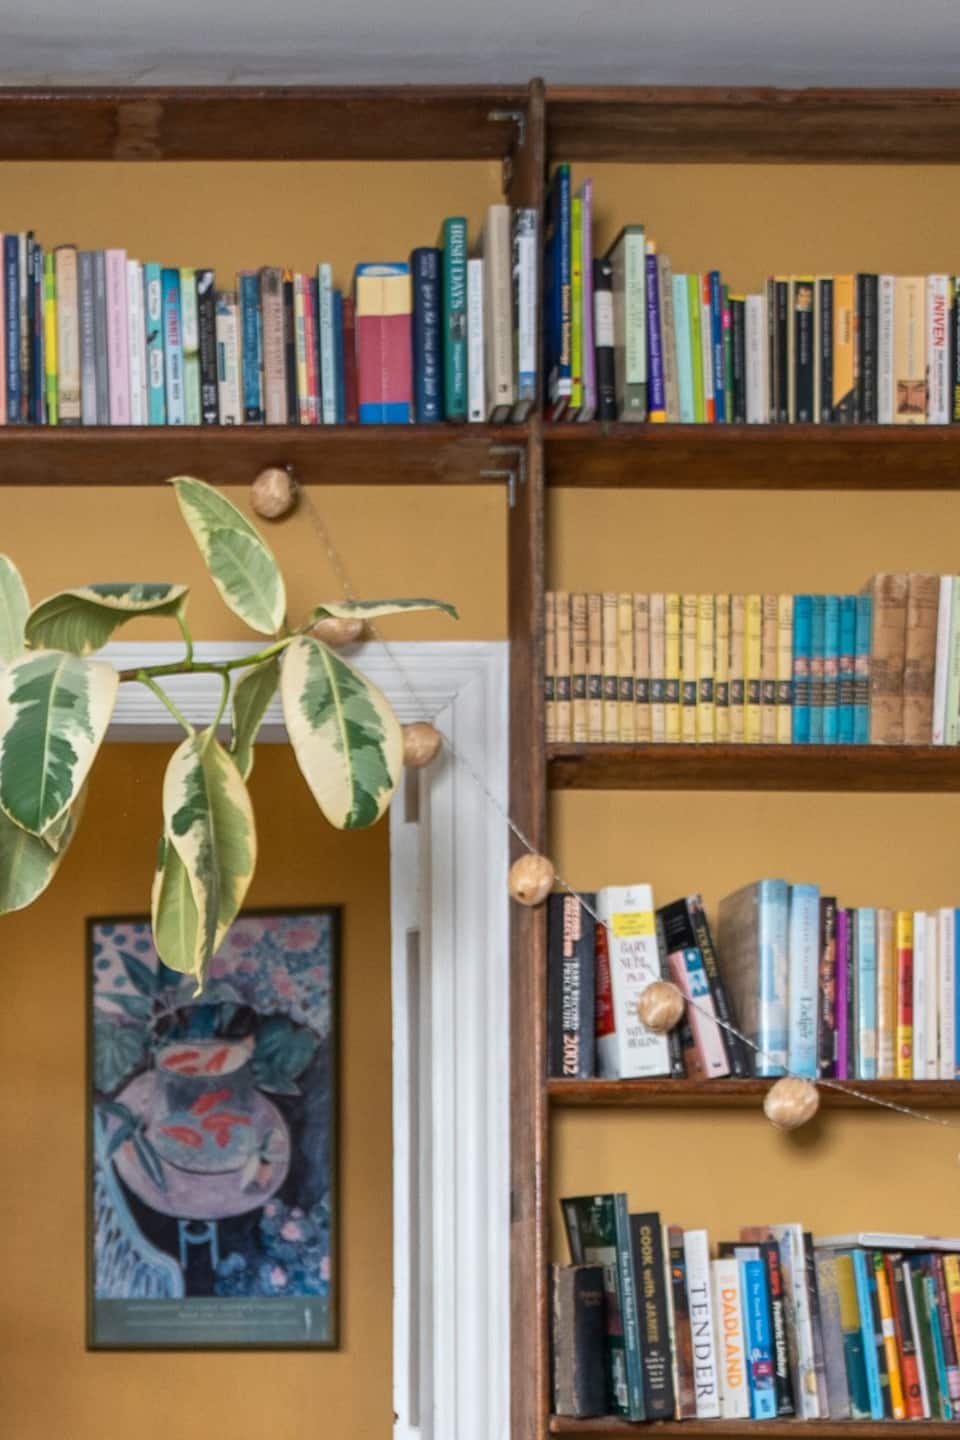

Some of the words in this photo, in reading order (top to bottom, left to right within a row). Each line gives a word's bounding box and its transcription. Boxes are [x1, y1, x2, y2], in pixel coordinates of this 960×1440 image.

[450, 223, 466, 264] IRISH
[450, 267, 467, 309] DAYS
[560, 284, 570, 314] Science
[933, 300, 945, 347] NIVEN
[559, 323, 571, 366] Technology
[620, 942, 647, 953] GARY
[563, 1034, 580, 1075] 2002
[640, 1225, 654, 1266] COOK
[644, 1268, 657, 1298] with
[645, 1301, 659, 1344] JAMIE
[690, 1282, 715, 1399] TENDER
[721, 1287, 743, 1389] DADLAND
[775, 1341, 788, 1379] Lindsay
